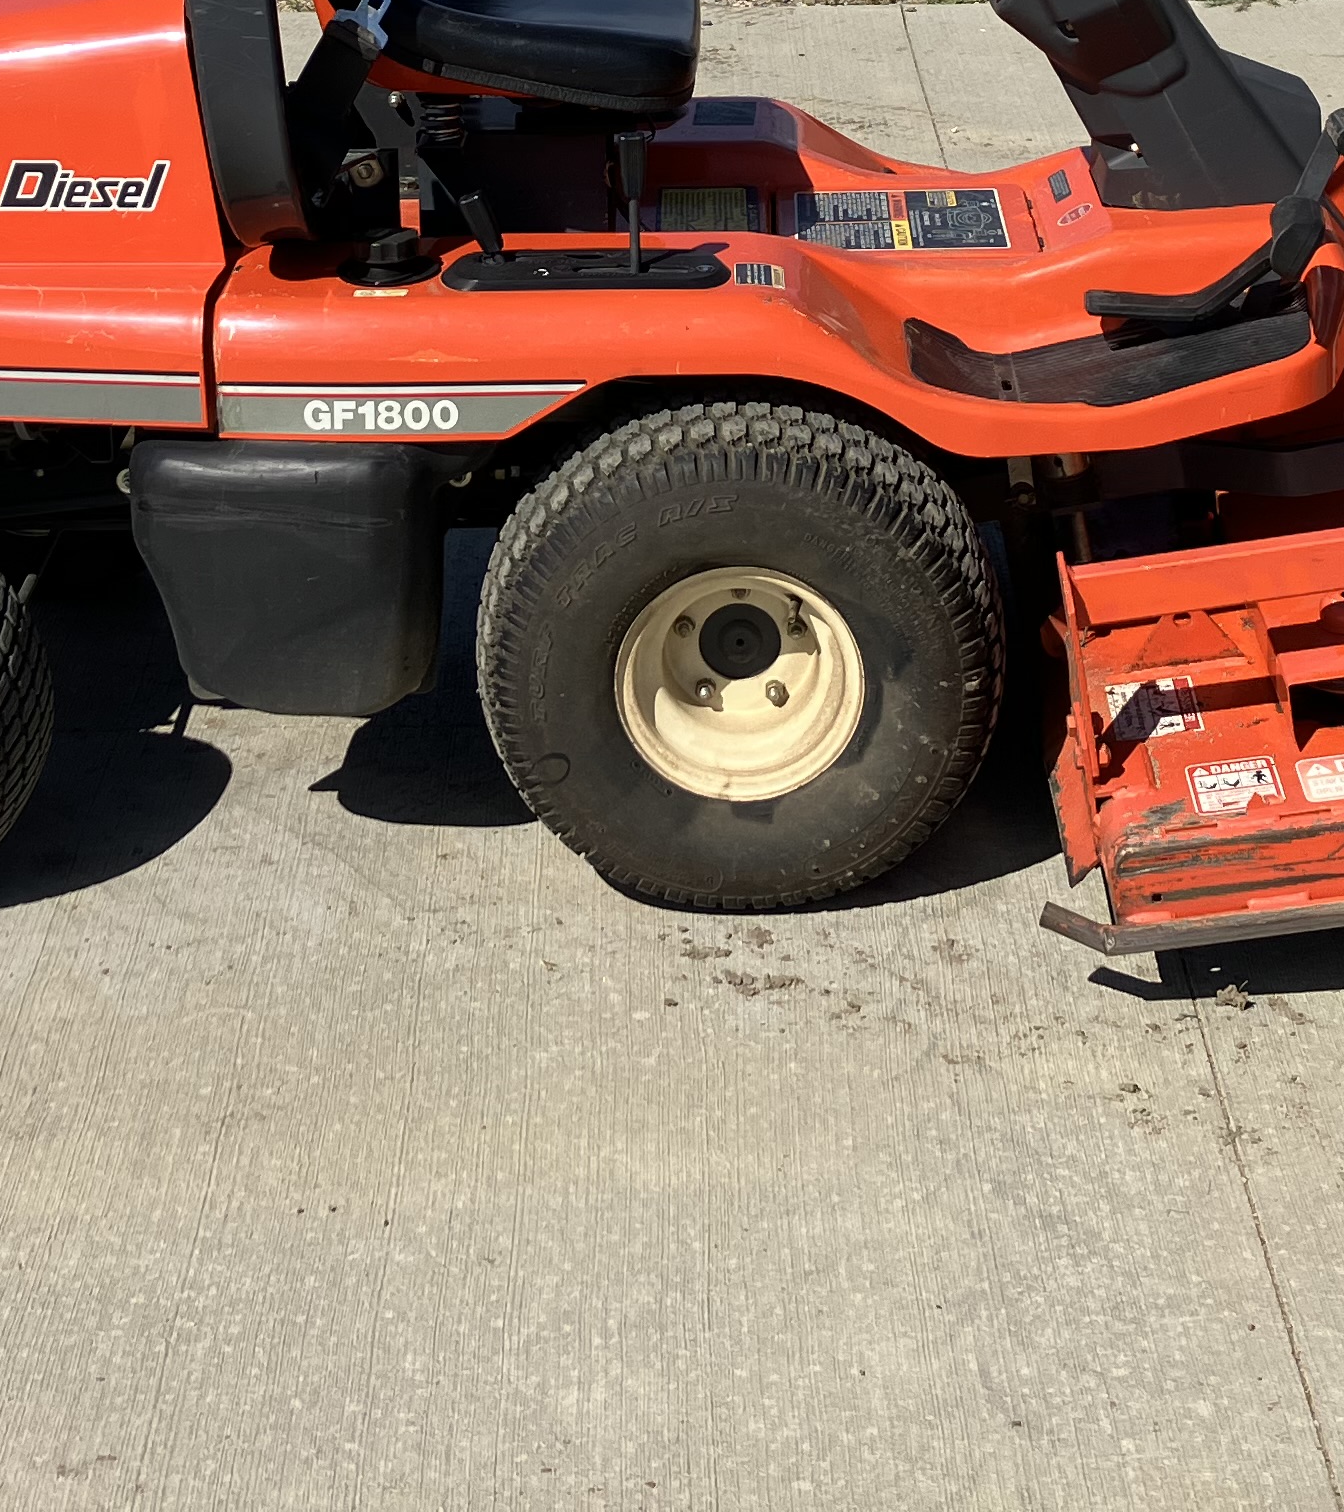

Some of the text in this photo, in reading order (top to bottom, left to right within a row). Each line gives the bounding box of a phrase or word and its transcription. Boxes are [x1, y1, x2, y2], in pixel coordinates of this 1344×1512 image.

[895, 227, 909, 246] CAUTION
[303, 399, 459, 430] GF1800
[1210, 759, 1268, 775] DANGER
[1312, 775, 1336, 787] STAY
